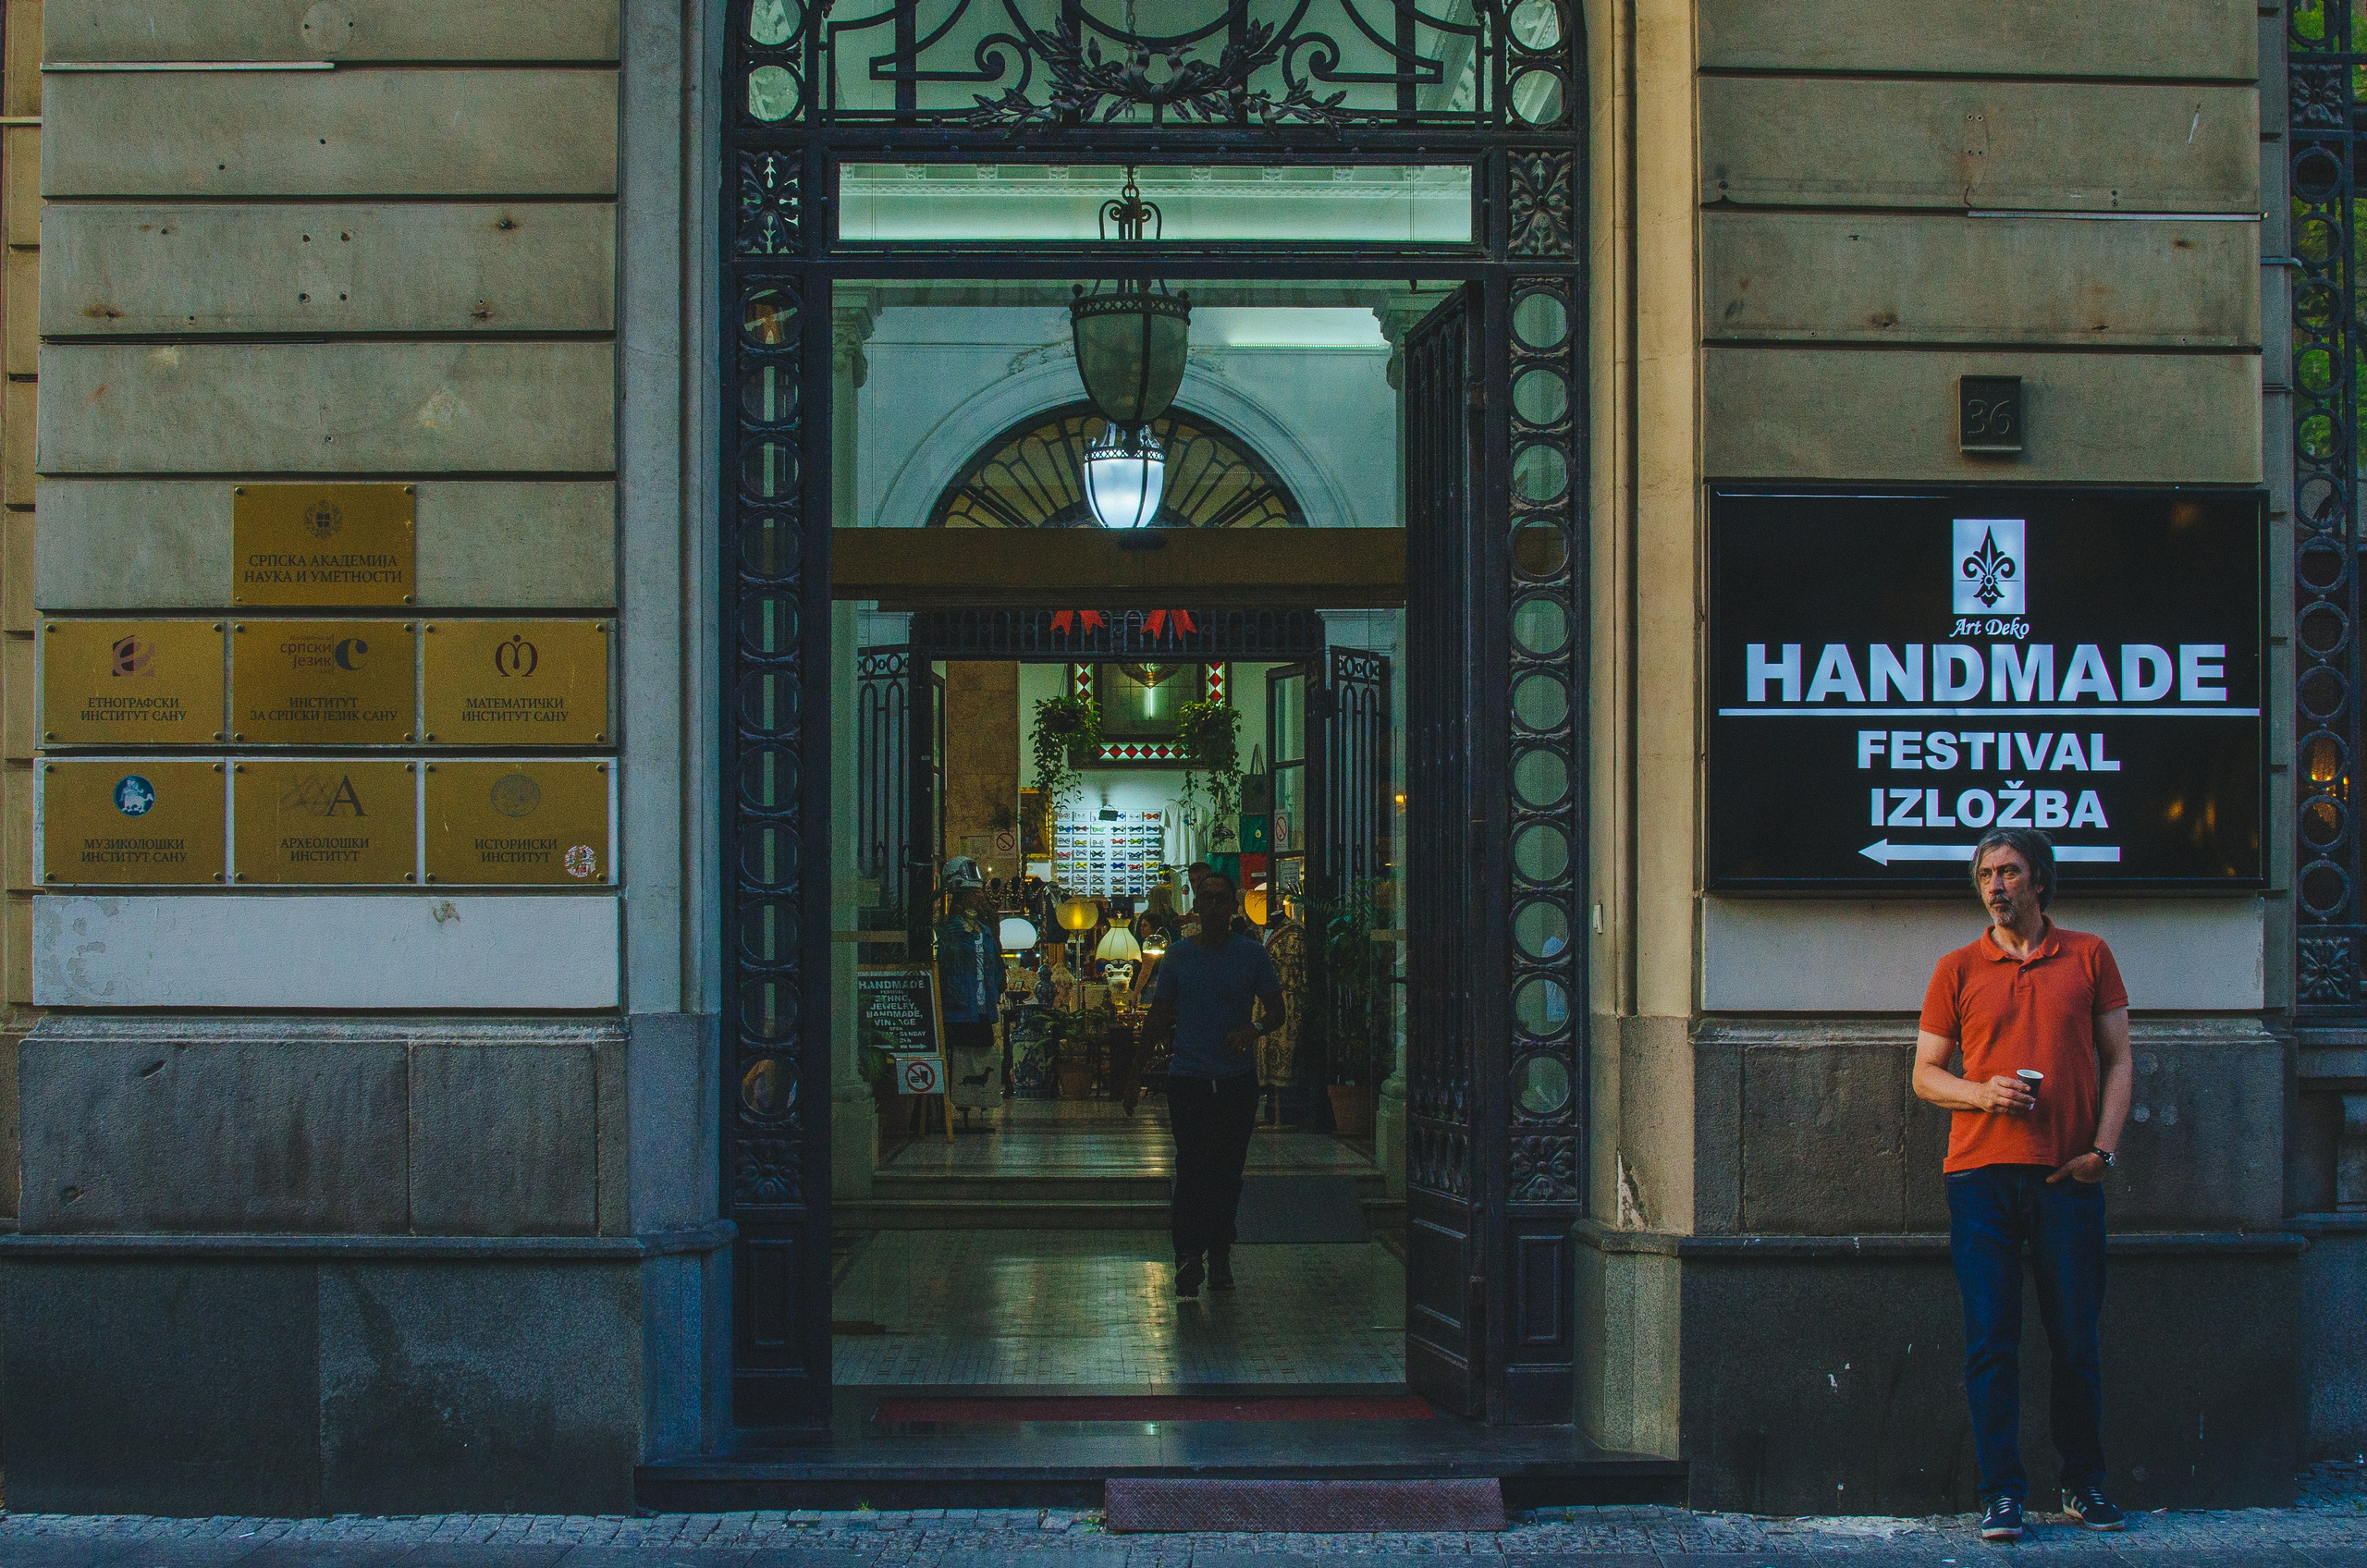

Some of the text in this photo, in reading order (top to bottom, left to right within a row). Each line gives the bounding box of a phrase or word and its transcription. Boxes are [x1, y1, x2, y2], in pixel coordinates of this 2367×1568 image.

[1967, 398, 2013, 436] 36
[249, 555, 399, 570] СРПСКА АКАДЕМИЈА
[244, 570, 402, 582] НАУКА И УМЕТНОСТИ
[1949, 617, 2030, 640] Art Deko
[280, 643, 332, 655] српски
[293, 655, 332, 668] језик
[1746, 643, 2227, 703] HANDMADE
[88, 697, 179, 708] ЕТНОГРАФСКИ
[289, 697, 359, 708] ИНСТИТУТ
[466, 697, 564, 709] МАТЕМАТИЧКИ
[80, 710, 187, 721] ИНСТИТУТ САНУ
[250, 710, 399, 723] ЗА СРПСКИ ЈЕЗИК САНУ
[461, 711, 570, 722] ИНСТИТУТ САНУ
[1858, 730, 2121, 771] FESTIVAL
[1870, 780, 2109, 828] IZLOŽBA
[84, 839, 184, 850] МУЗИКОЛОШКИ
[280, 838, 369, 849] АРХЕОЛОШКИ
[474, 839, 558, 851] ИСТОРИЈСКИ
[81, 851, 188, 863] ИНСТИТУТ САНУ
[290, 851, 360, 862] ИНСТИТУТ
[482, 851, 550, 863] ИНСТИТУТ
[858, 980, 926, 989] HANDMADE
